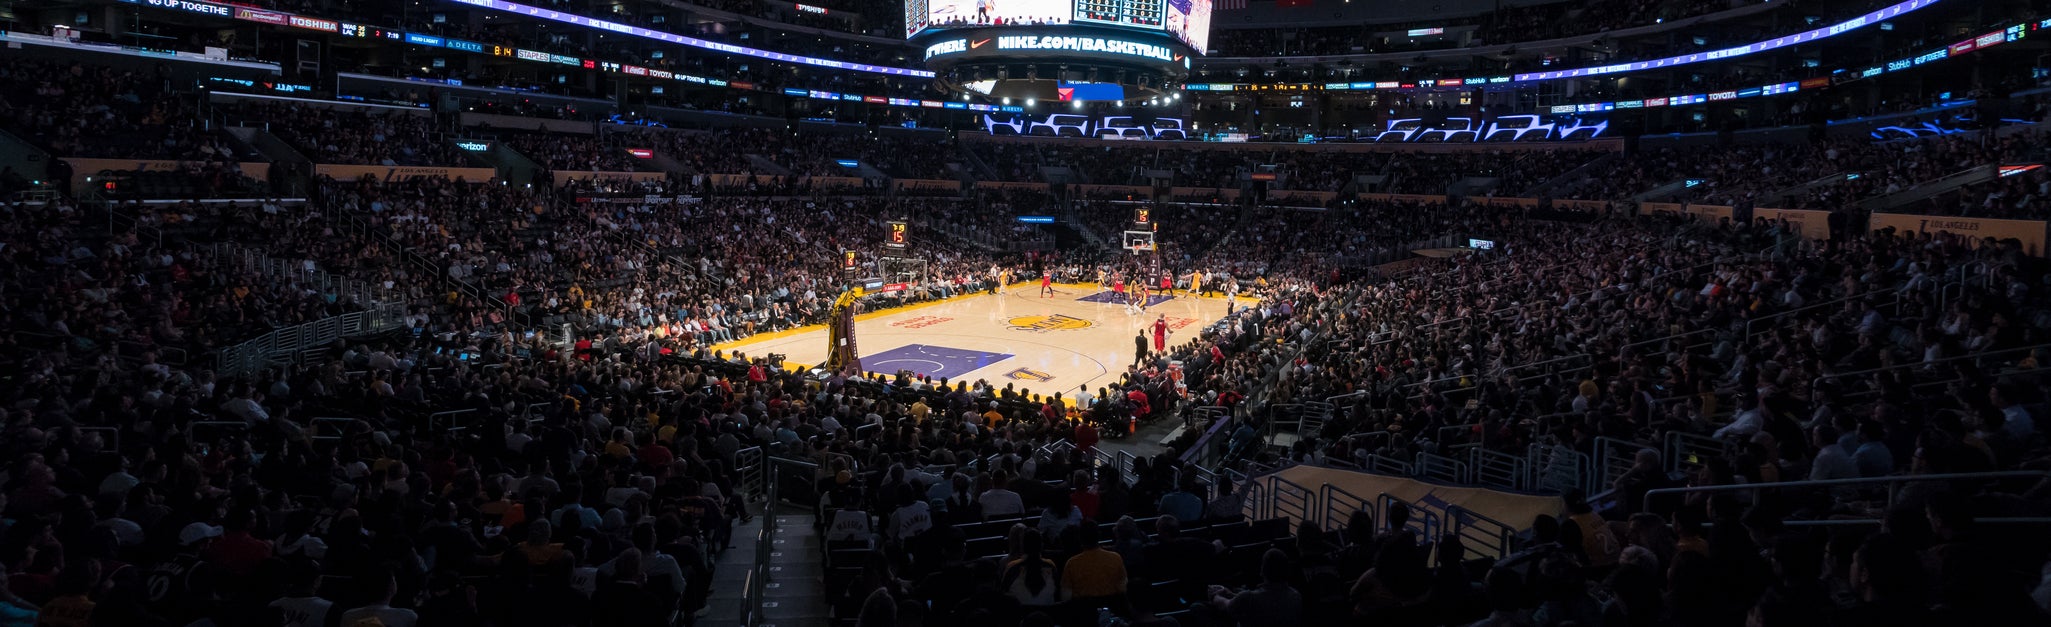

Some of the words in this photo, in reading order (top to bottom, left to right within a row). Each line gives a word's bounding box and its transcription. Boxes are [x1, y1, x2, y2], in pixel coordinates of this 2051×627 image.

[163, 0, 179, 8] UP
[291, 17, 337, 31] TOSHIBA
[342, 23, 356, 31] WAS
[456, 41, 482, 51] DELTA
[494, 46, 511, 56] 8:14
[998, 36, 1172, 62] NIKE.COM/BASKETBALL
[519, 50, 549, 61] STAPLES
[649, 69, 672, 79] TOYOTA
[708, 79, 727, 87] verizon
[1708, 91, 1737, 101] TOYOTA
[893, 231, 904, 243] 15
